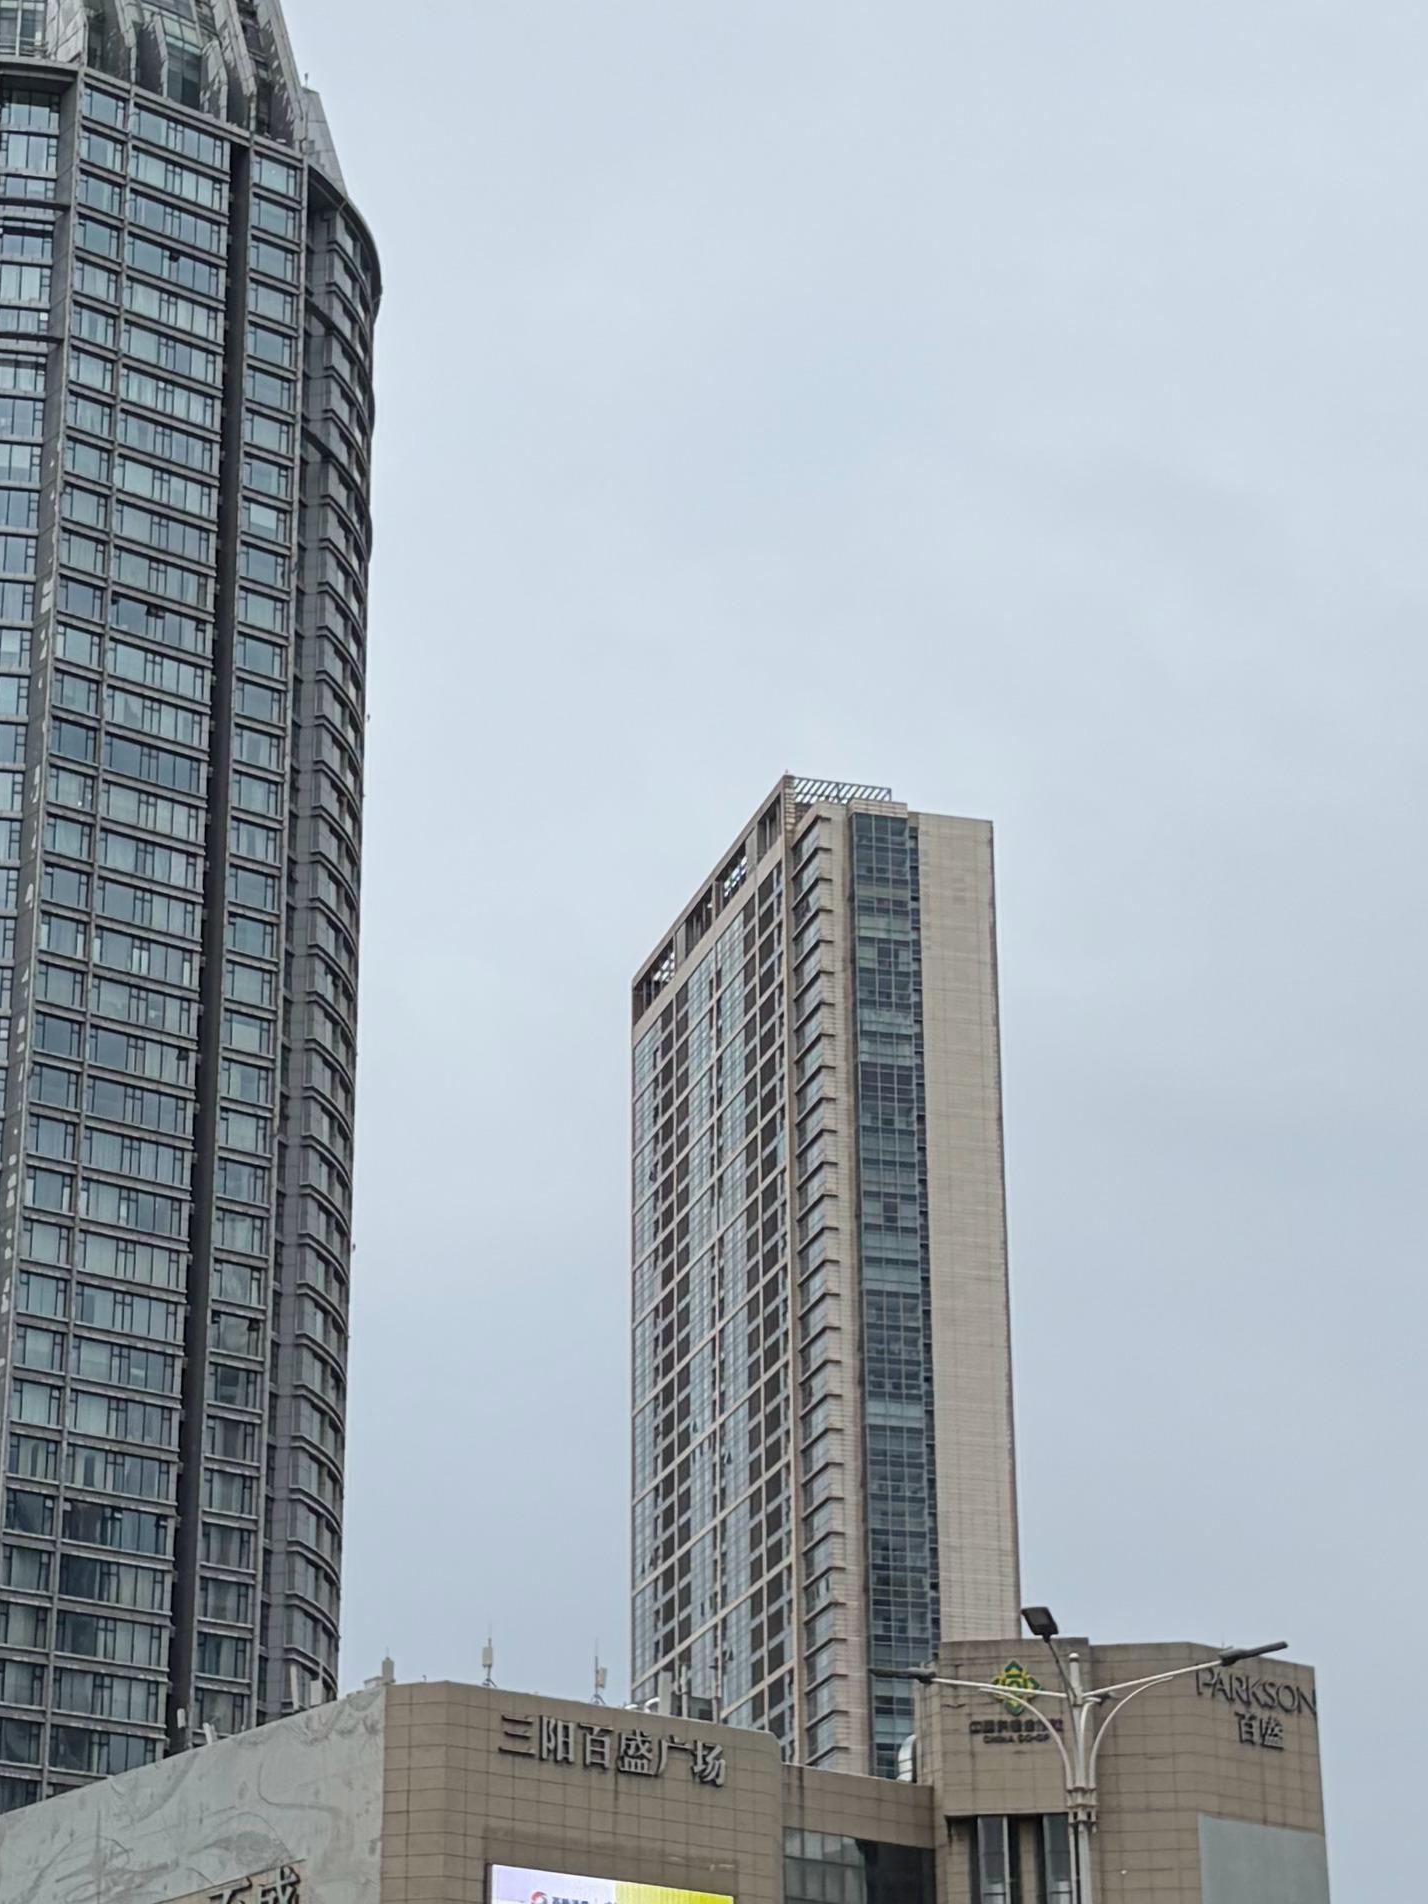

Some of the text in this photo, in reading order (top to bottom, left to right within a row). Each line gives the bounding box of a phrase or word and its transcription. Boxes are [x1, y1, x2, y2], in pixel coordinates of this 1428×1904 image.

[1196, 1667, 1318, 1718] PARKSON
[498, 1714, 726, 1788] 三阳百盛广场
[1234, 1710, 1284, 1750] 百盛
